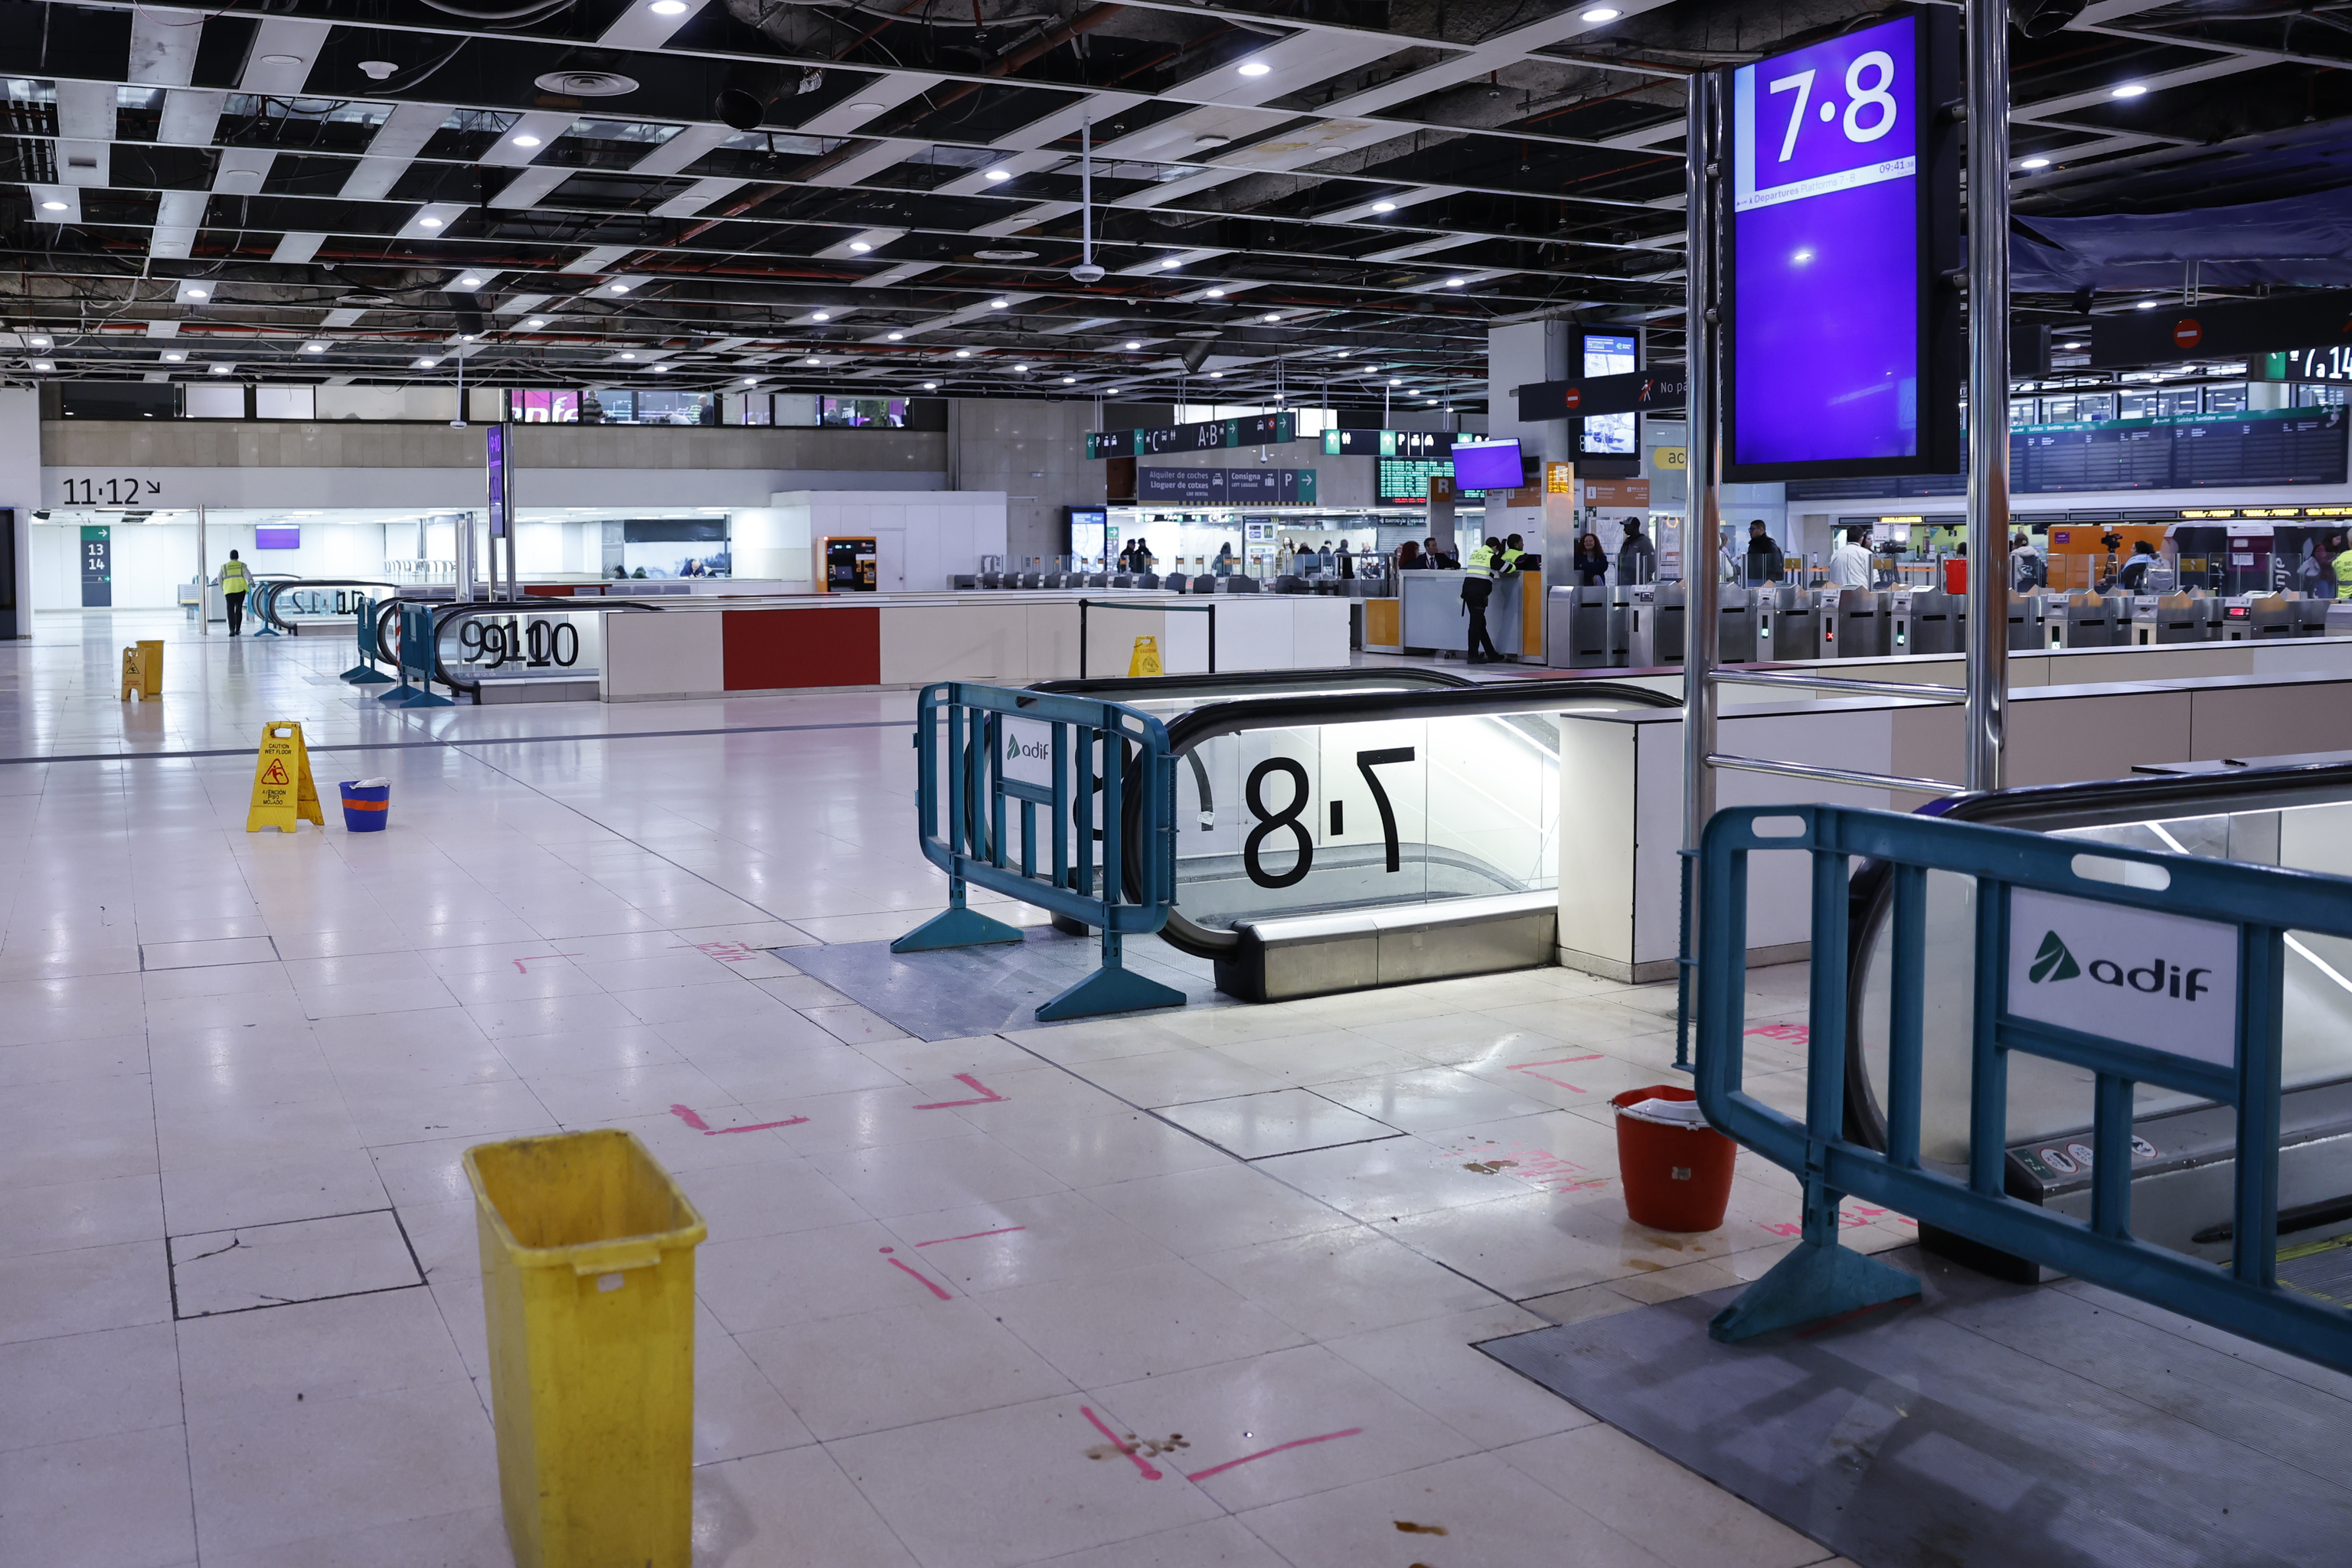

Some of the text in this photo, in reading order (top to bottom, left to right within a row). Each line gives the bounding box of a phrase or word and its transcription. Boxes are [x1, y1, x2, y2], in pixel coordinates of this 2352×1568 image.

[1754, 188, 1799, 204] Departures
[1800, 178, 1838, 193] Platforms
[1661, 382, 1674, 394] No
[1152, 430, 1160, 452] C
[1149, 471, 1175, 479] Alquiler
[1231, 473, 1261, 482] Consigna
[1285, 473, 1292, 487] P
[1150, 481, 1176, 490] Lloguer
[1437, 479, 1450, 494] R
[88, 544, 104, 556] 13
[88, 558, 105, 570] 14
[1021, 741, 1050, 760] adif
[2089, 959, 2213, 1001] adif
